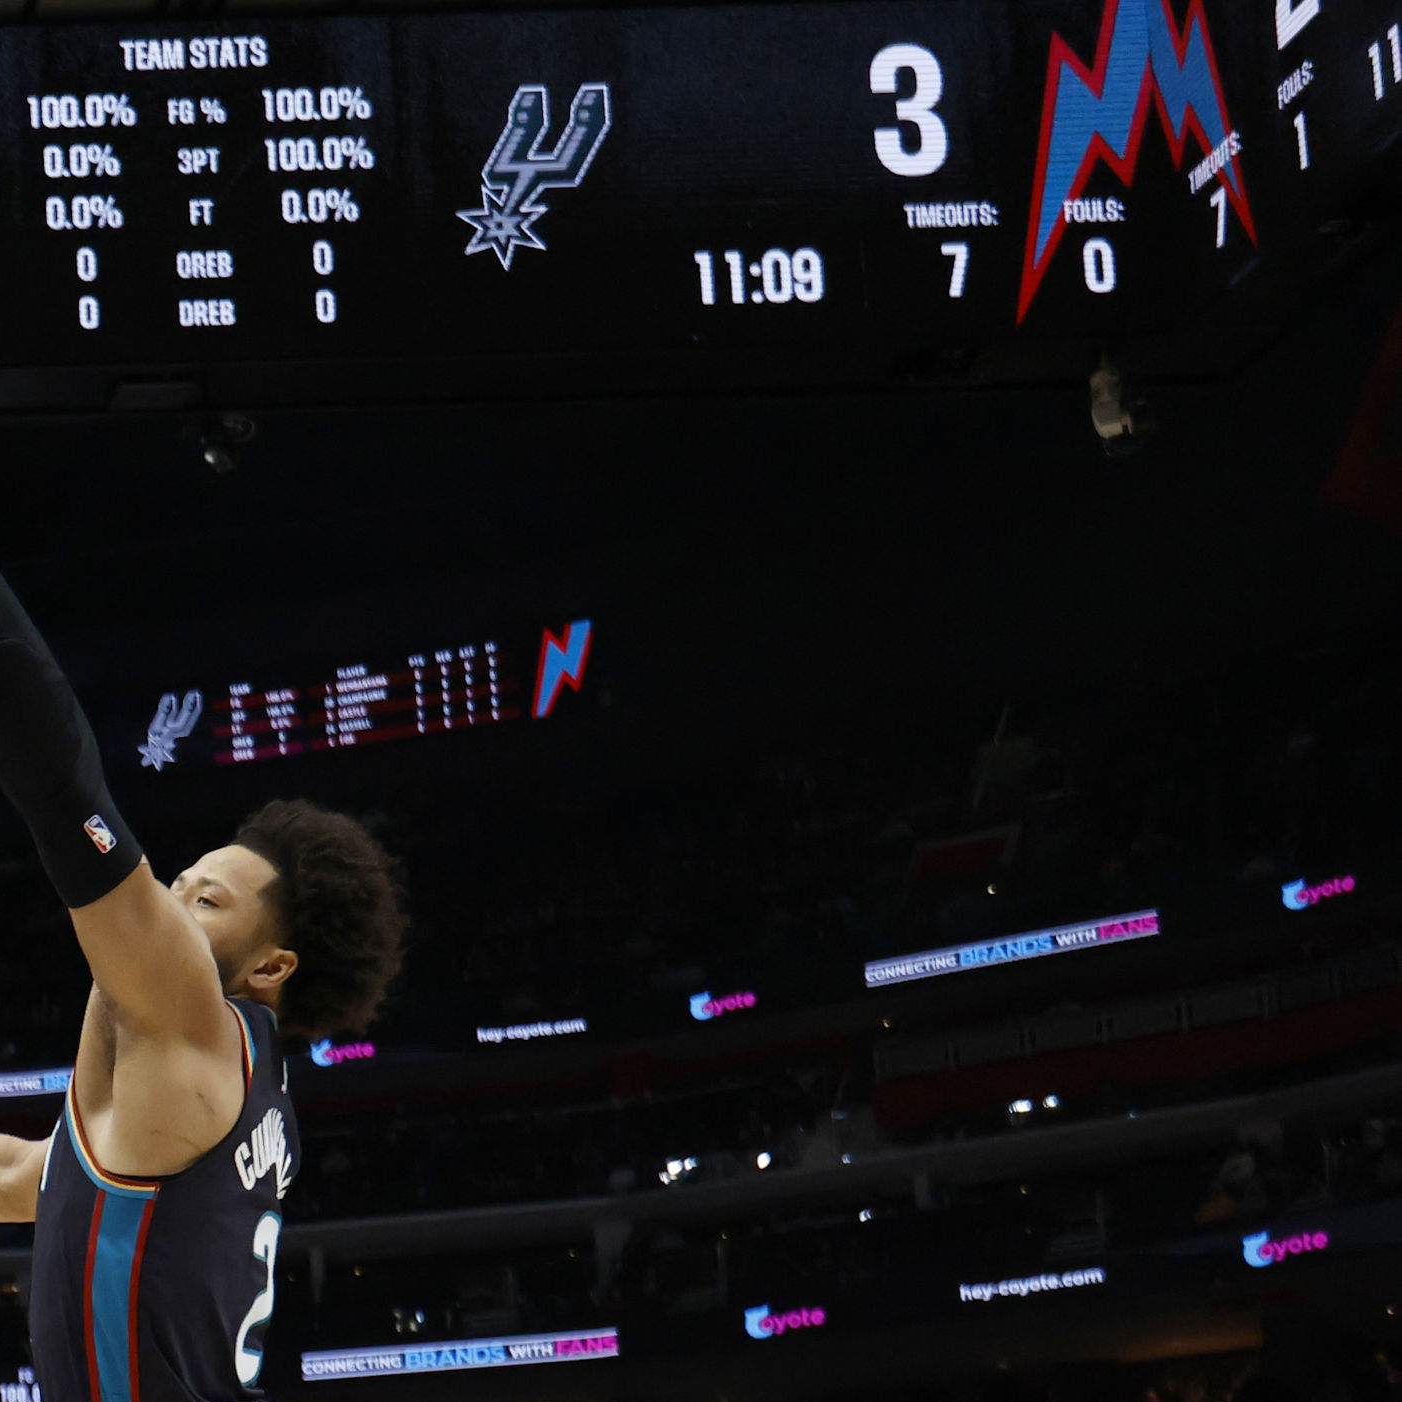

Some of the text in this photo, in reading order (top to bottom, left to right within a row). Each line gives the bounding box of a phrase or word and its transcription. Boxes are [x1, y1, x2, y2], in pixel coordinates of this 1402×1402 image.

[120, 36, 268, 71] TEAM STATS
[27, 86, 372, 130] 100.0% FG % 100.0%
[869, 43, 949, 178] 3
[43, 136, 375, 179] 0.0% 3PT 100.0%
[1293, 110, 1311, 171] 1
[45, 188, 360, 231] 0.0% FT 0.0%
[903, 200, 1000, 229] TIMEOUTS:
[1063, 197, 1127, 224] FOULS:
[76, 239, 334, 282] 0 OREB 0
[694, 246, 825, 305] 11:09
[940, 242, 970, 298] 7
[1082, 235, 1117, 293] 0
[78, 288, 337, 331] 0 DREB 0
[866, 955, 957, 983] CONNECTING
[959, 935, 1053, 968] BRANDS
[1055, 927, 1097, 948] WITH
[302, 1355, 401, 1377] CONNECTING
[404, 1343, 506, 1370] BRANDS
[509, 1342, 553, 1361] WITH
